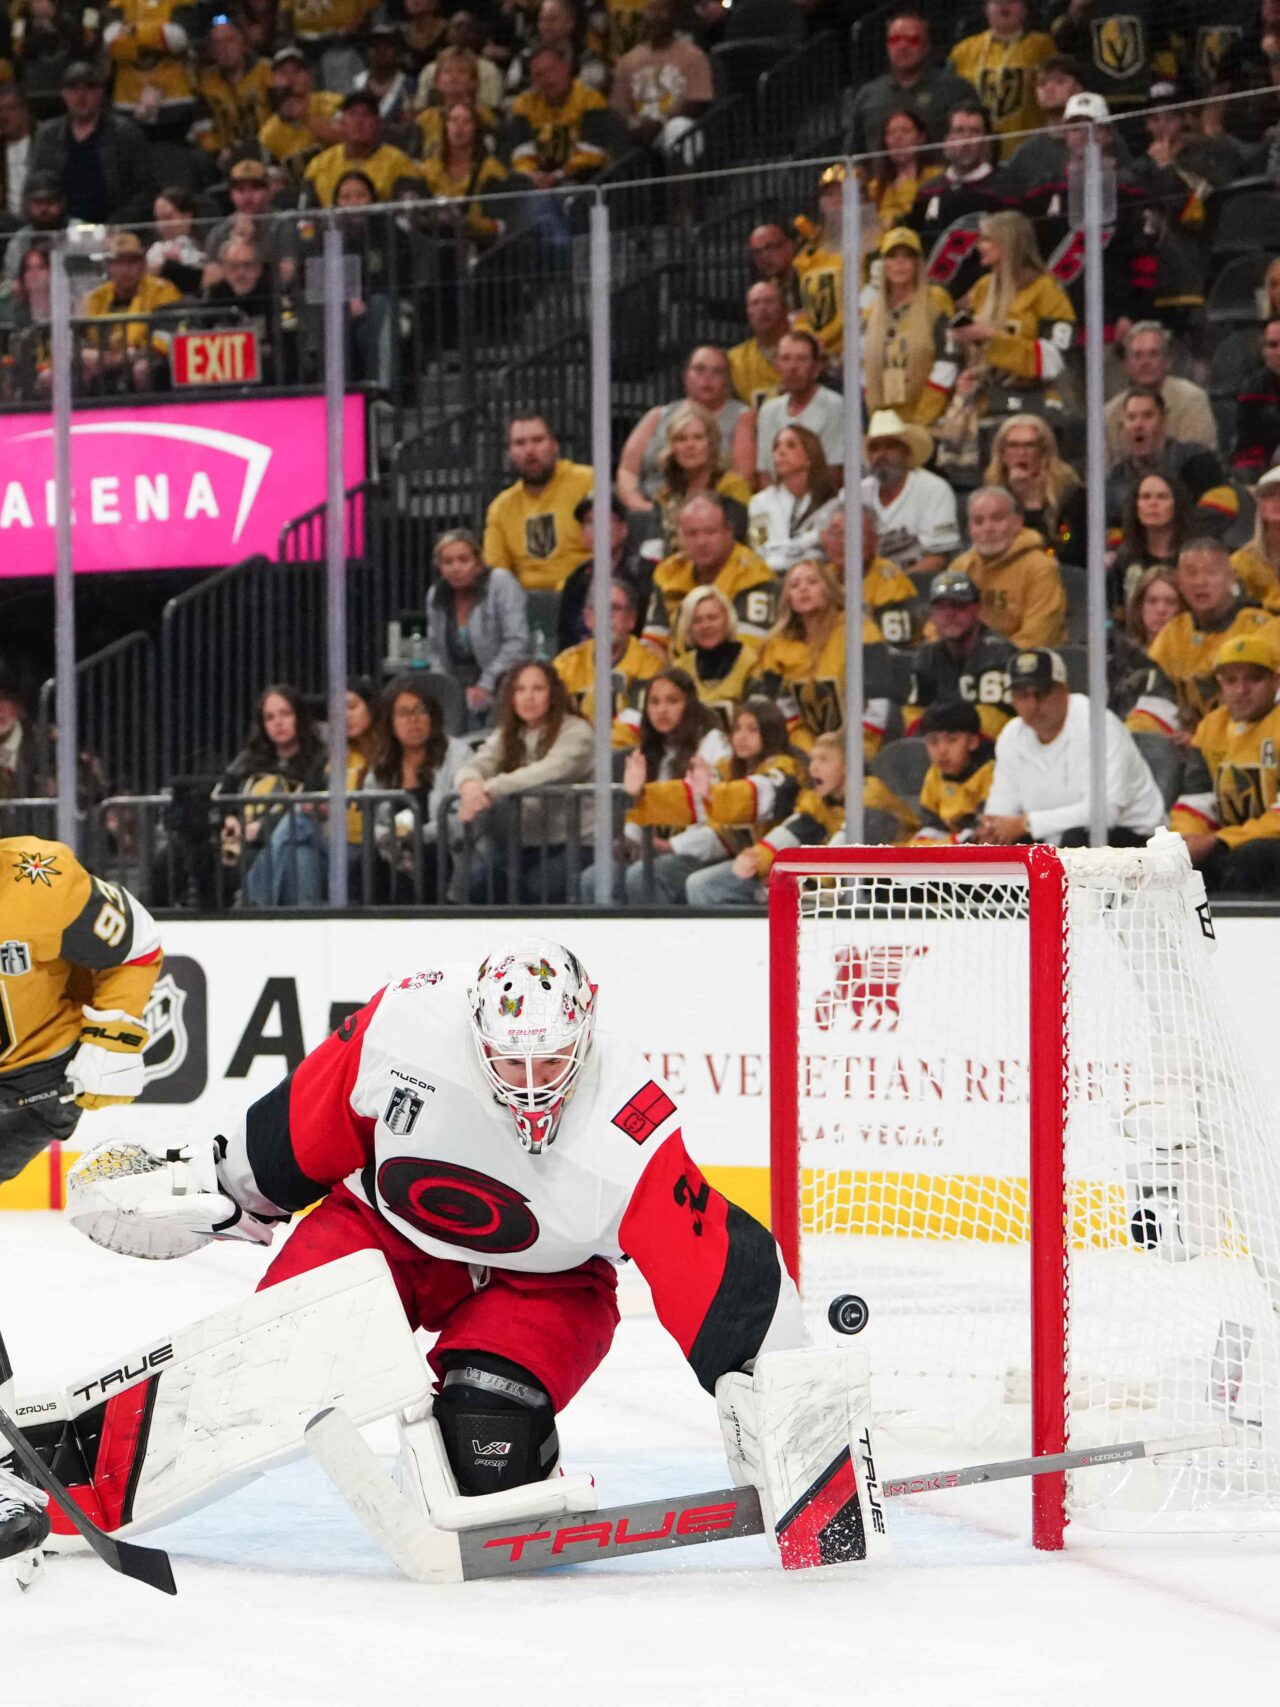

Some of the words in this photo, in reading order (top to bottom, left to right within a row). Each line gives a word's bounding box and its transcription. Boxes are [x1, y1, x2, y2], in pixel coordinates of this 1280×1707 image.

[186, 335, 246, 383] EXIT
[390, 1069, 437, 1094] NUCOR
[704, 1053, 946, 1102] VEETIAN
[73, 1343, 174, 1402] TRUE
[466, 1366, 529, 1399] VAUGHN
[858, 1427, 887, 1535] TRUE
[481, 1501, 738, 1562] TRUE
